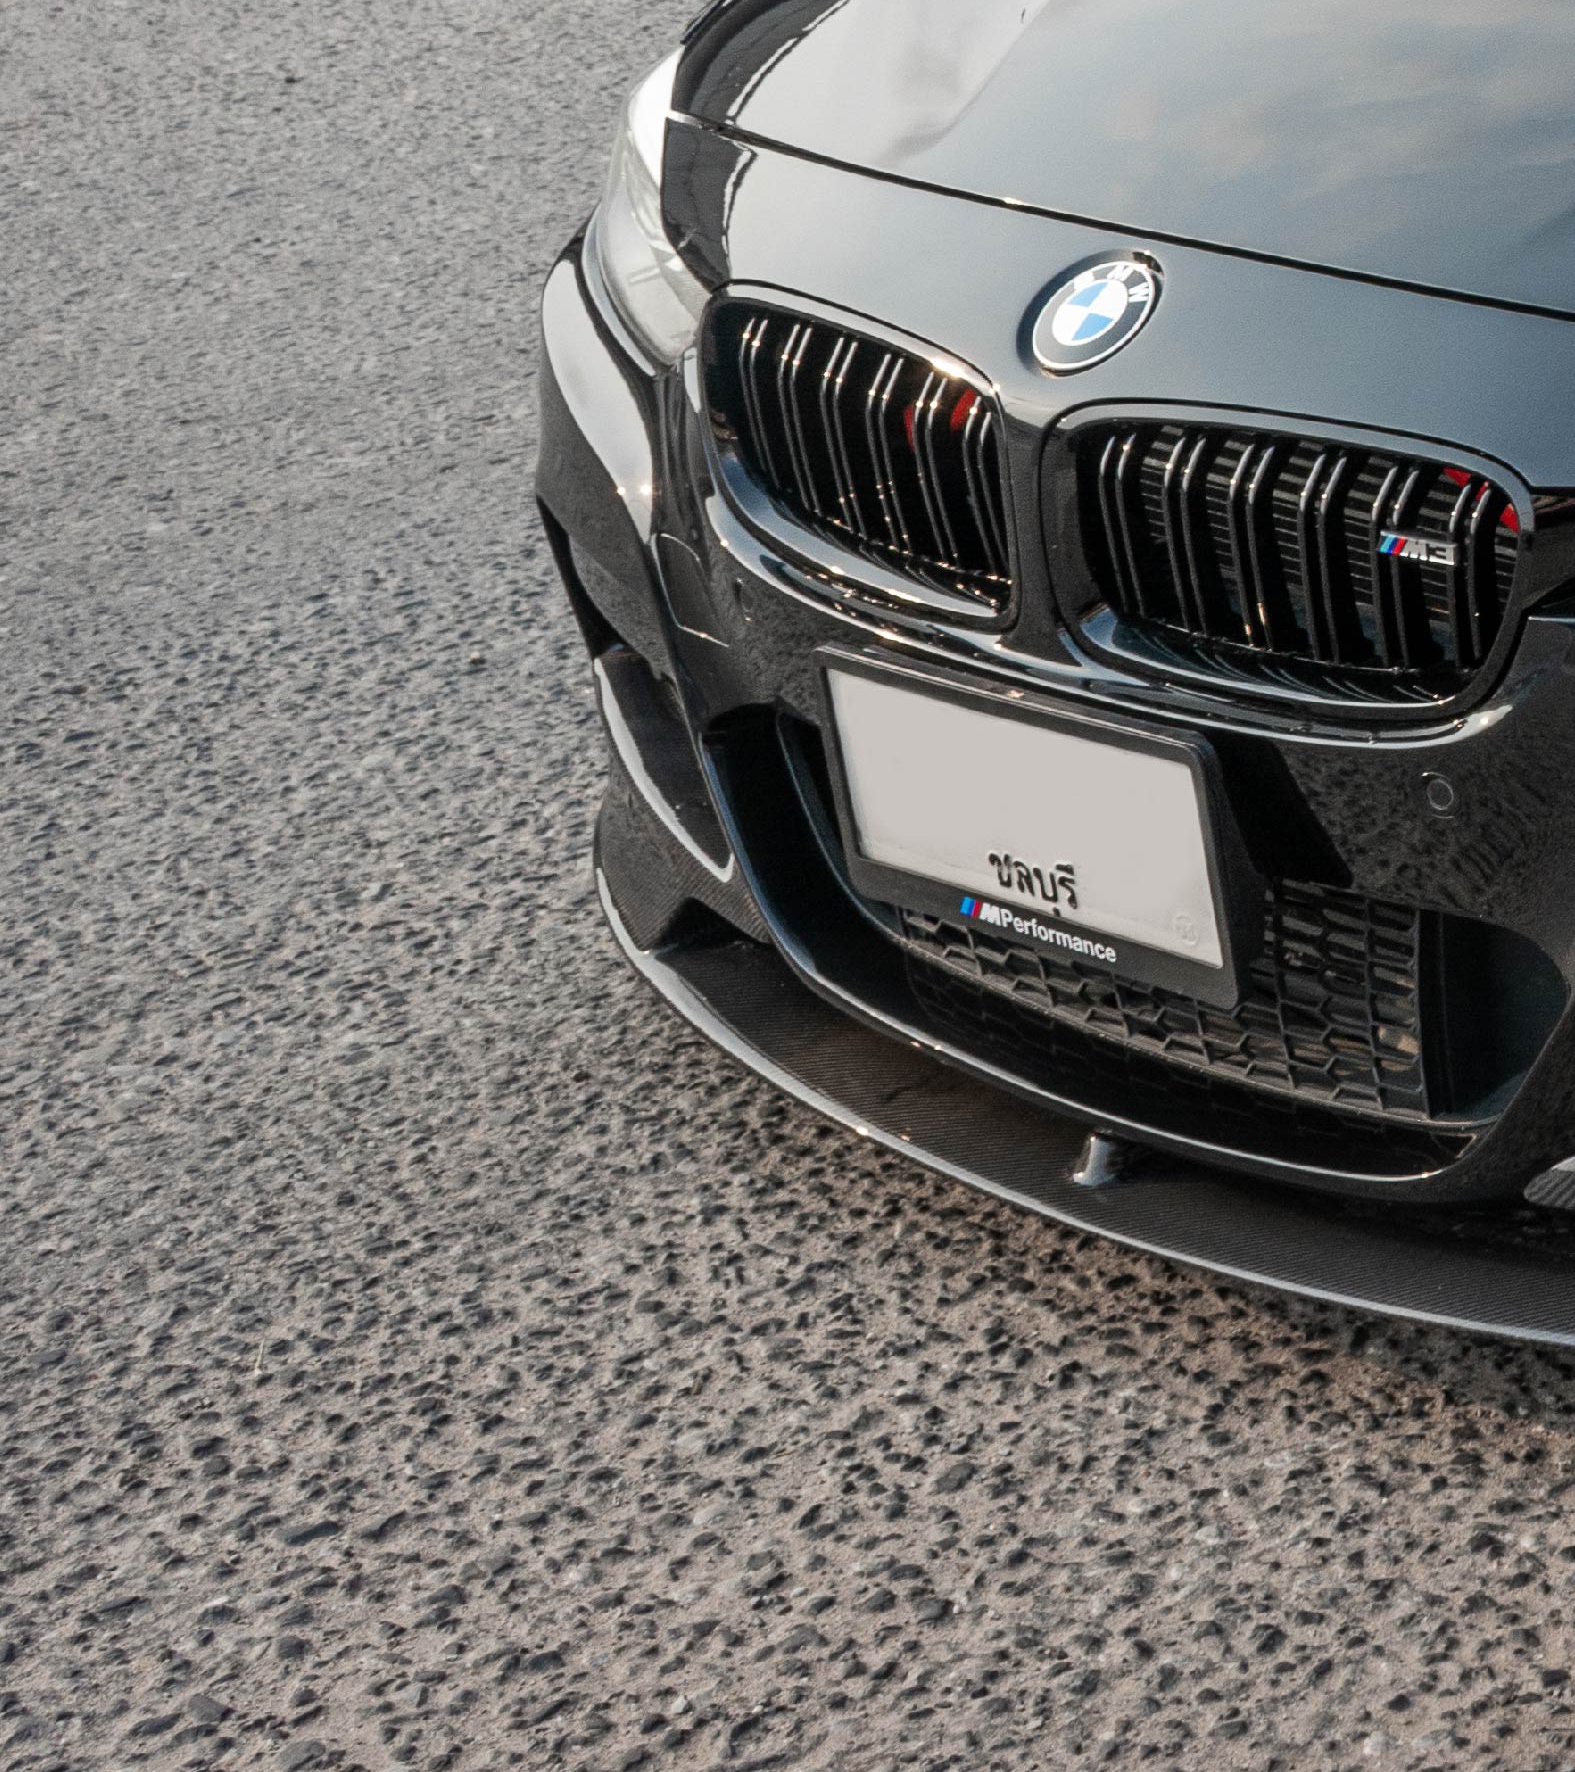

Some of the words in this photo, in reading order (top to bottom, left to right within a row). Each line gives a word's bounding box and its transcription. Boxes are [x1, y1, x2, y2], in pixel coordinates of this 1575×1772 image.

[1399, 537, 1457, 566] M3
[989, 851, 1079, 917] ชลบุรี
